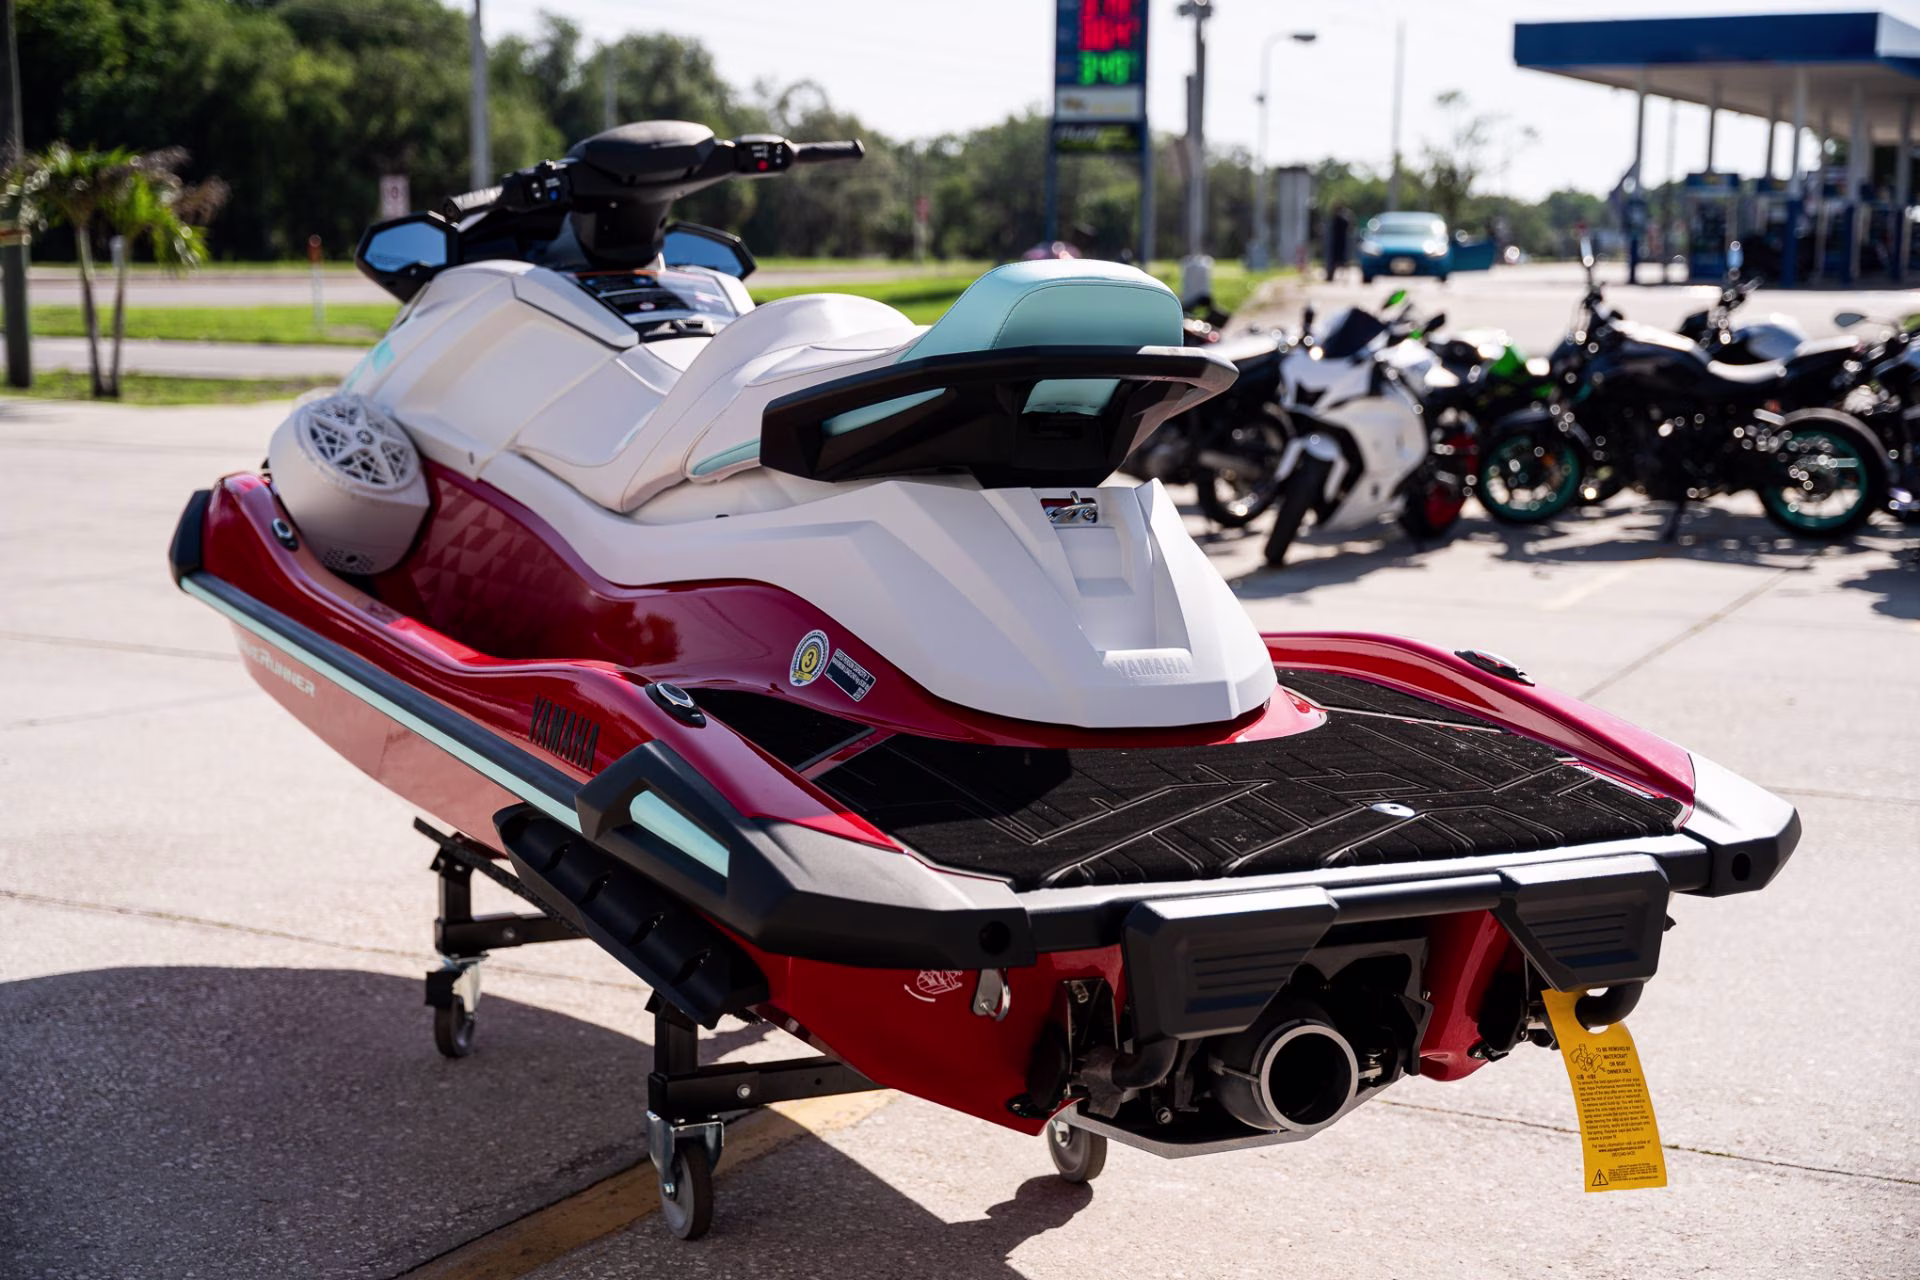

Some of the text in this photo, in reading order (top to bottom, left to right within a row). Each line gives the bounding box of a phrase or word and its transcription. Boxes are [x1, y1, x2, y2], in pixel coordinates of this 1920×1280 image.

[804, 651, 815, 668] 3
[1113, 657, 1191, 677] YAMAHA
[528, 694, 600, 772] YAMAHA
